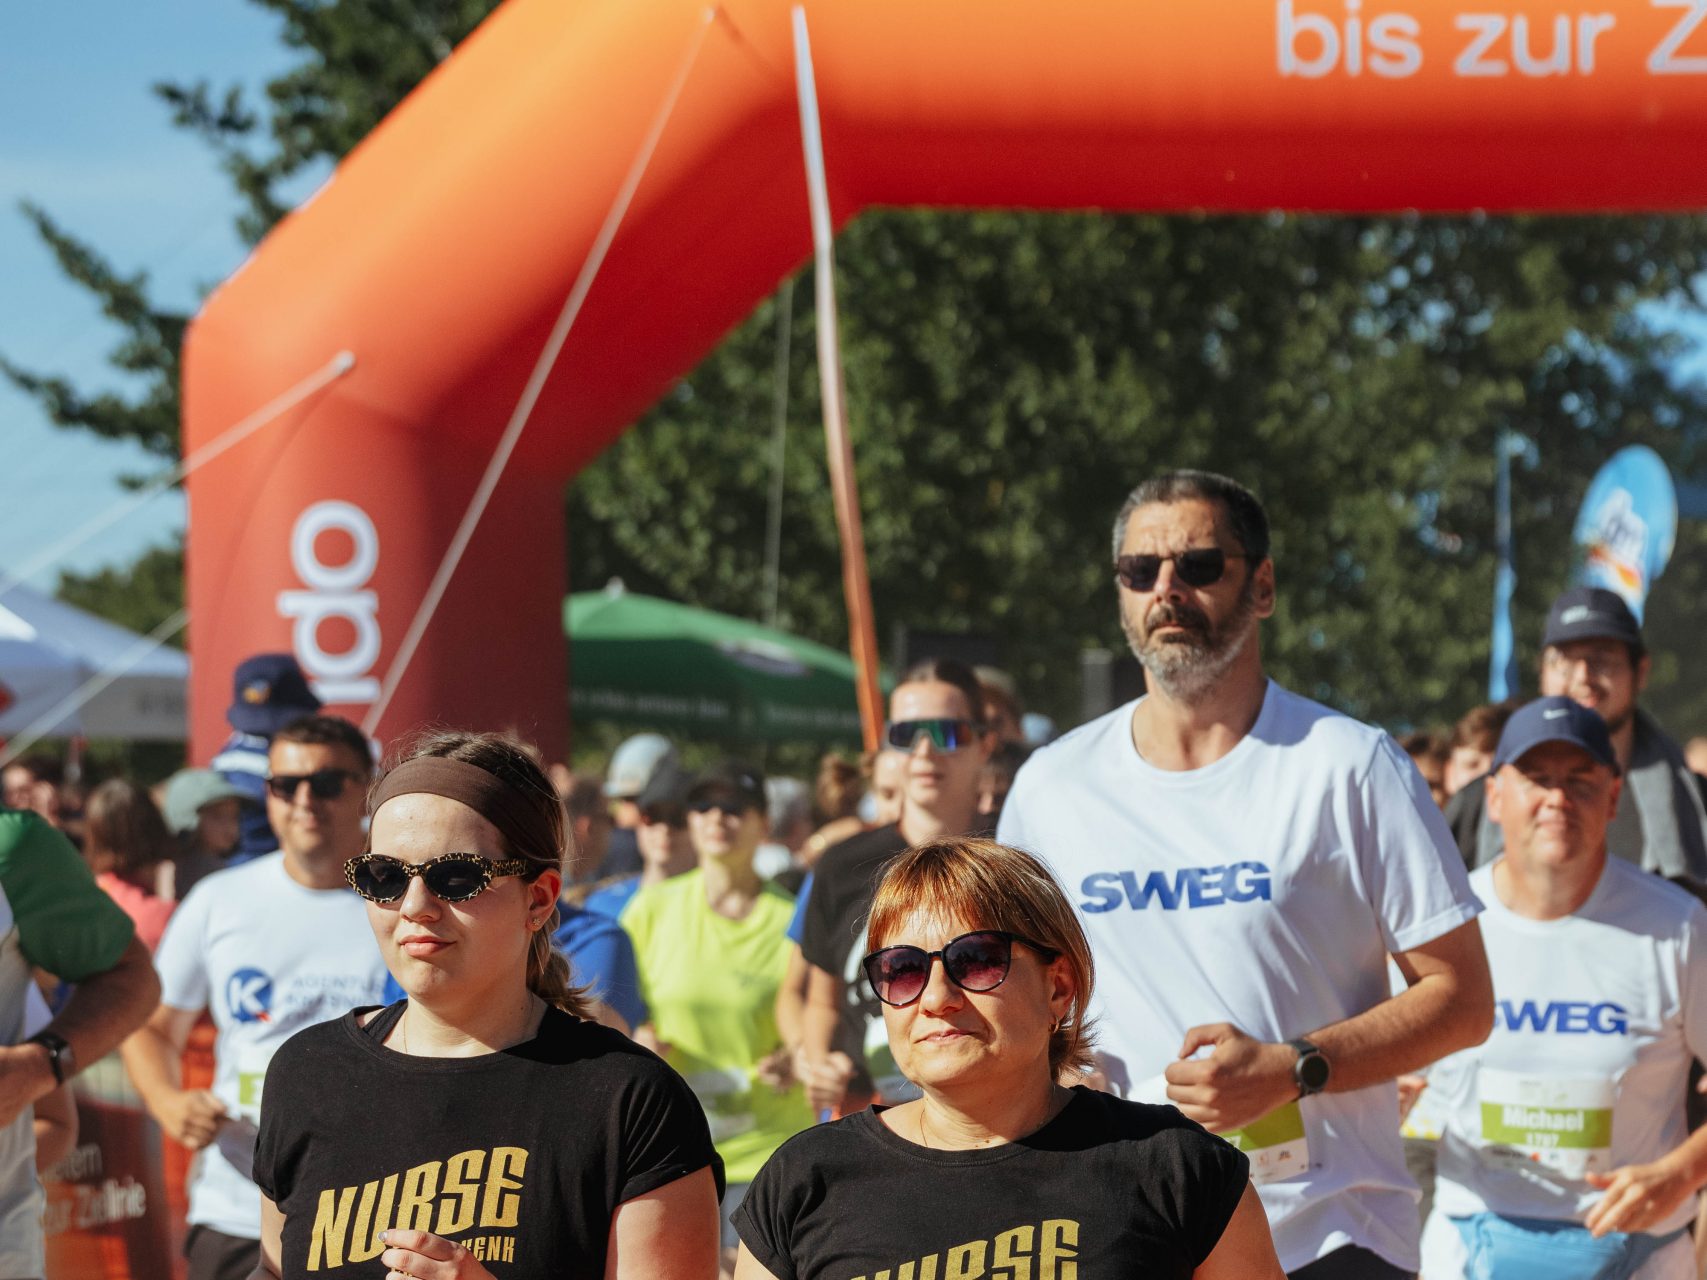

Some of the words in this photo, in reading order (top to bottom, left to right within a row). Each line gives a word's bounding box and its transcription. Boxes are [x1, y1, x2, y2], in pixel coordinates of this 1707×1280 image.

[1276, 0, 1423, 78] bis
[1453, 12, 1616, 78] zur
[1079, 860, 1273, 914] SWEG
[1495, 999, 1629, 1035] WEG
[1502, 1104, 1584, 1132] Michael
[306, 1146, 530, 1272] NURSE
